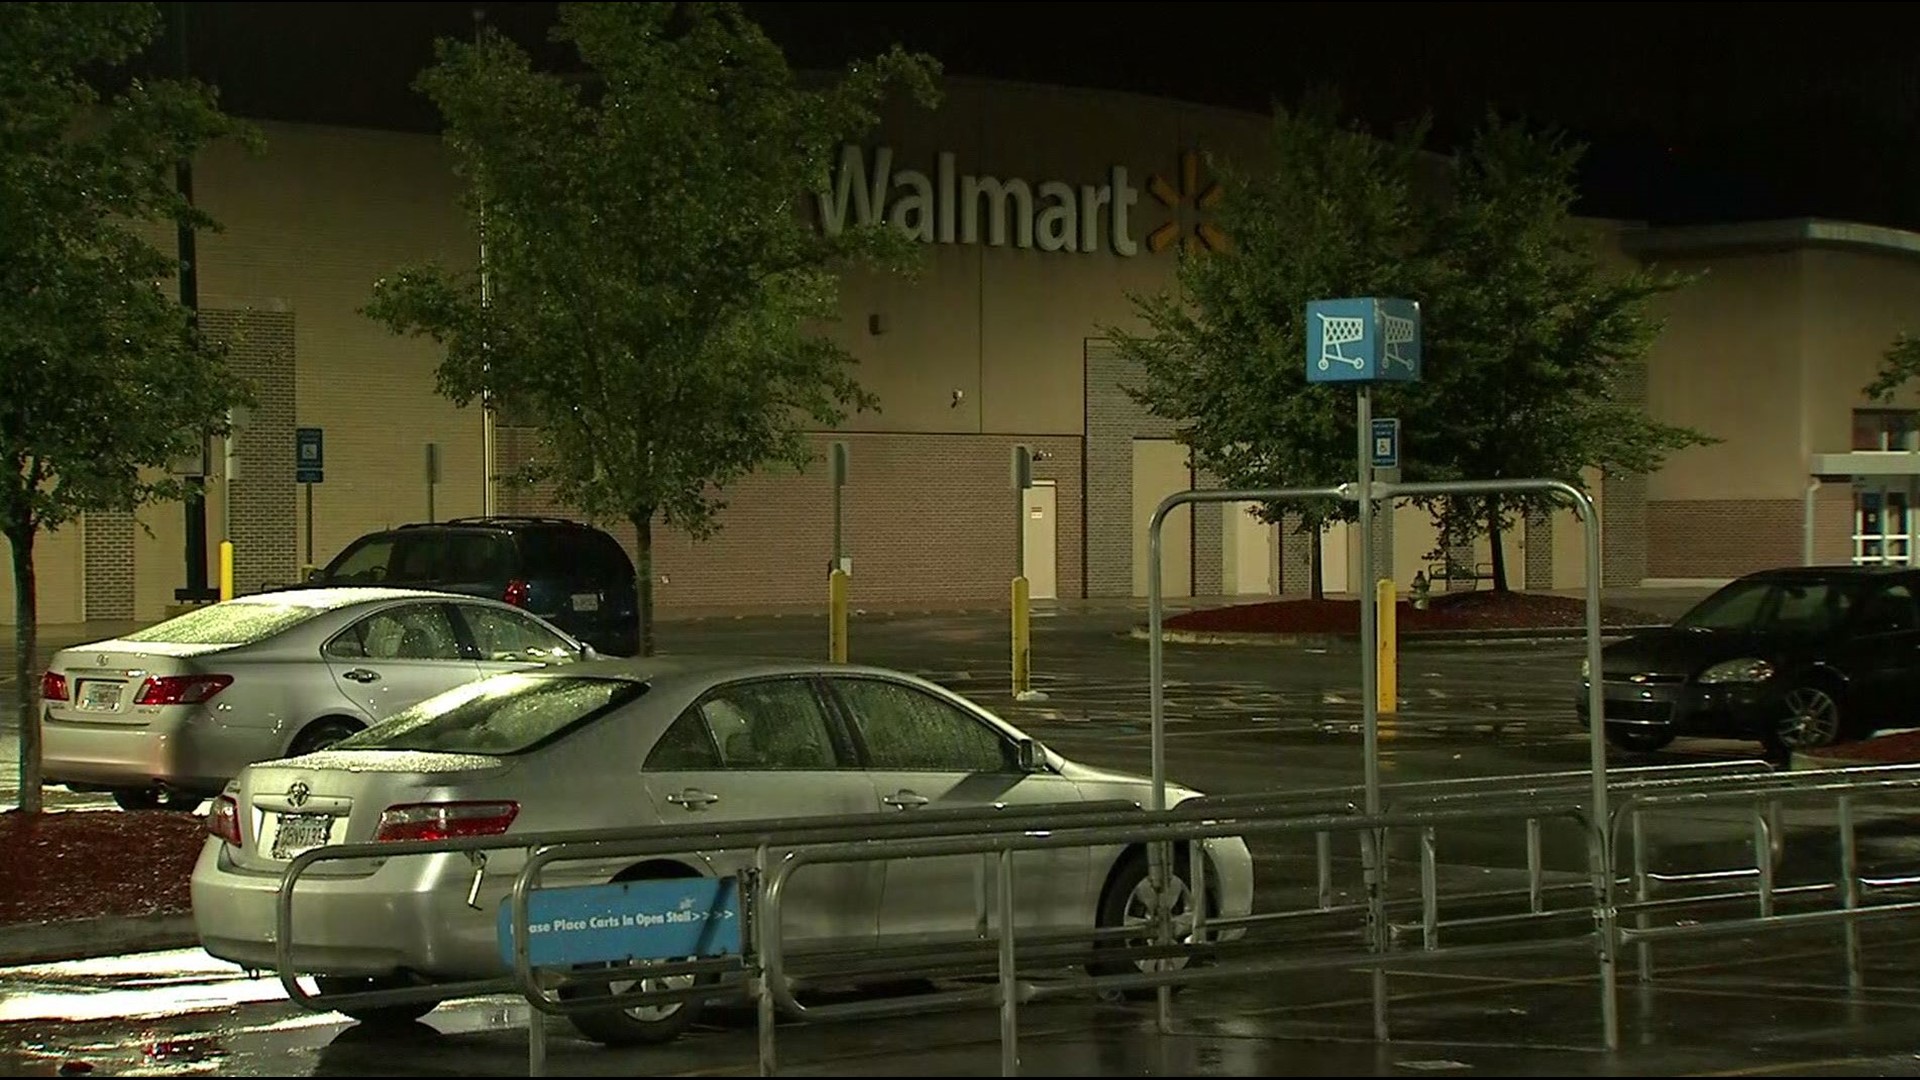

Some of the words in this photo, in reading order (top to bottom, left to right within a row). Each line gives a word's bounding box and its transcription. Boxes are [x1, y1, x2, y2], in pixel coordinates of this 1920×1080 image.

[815, 144, 1138, 257] Walmart
[553, 919, 587, 931] Place
[589, 916, 619, 928] Carts
[622, 914, 634, 926] In
[635, 912, 664, 927] Open
[665, 910, 692, 923] Stall
